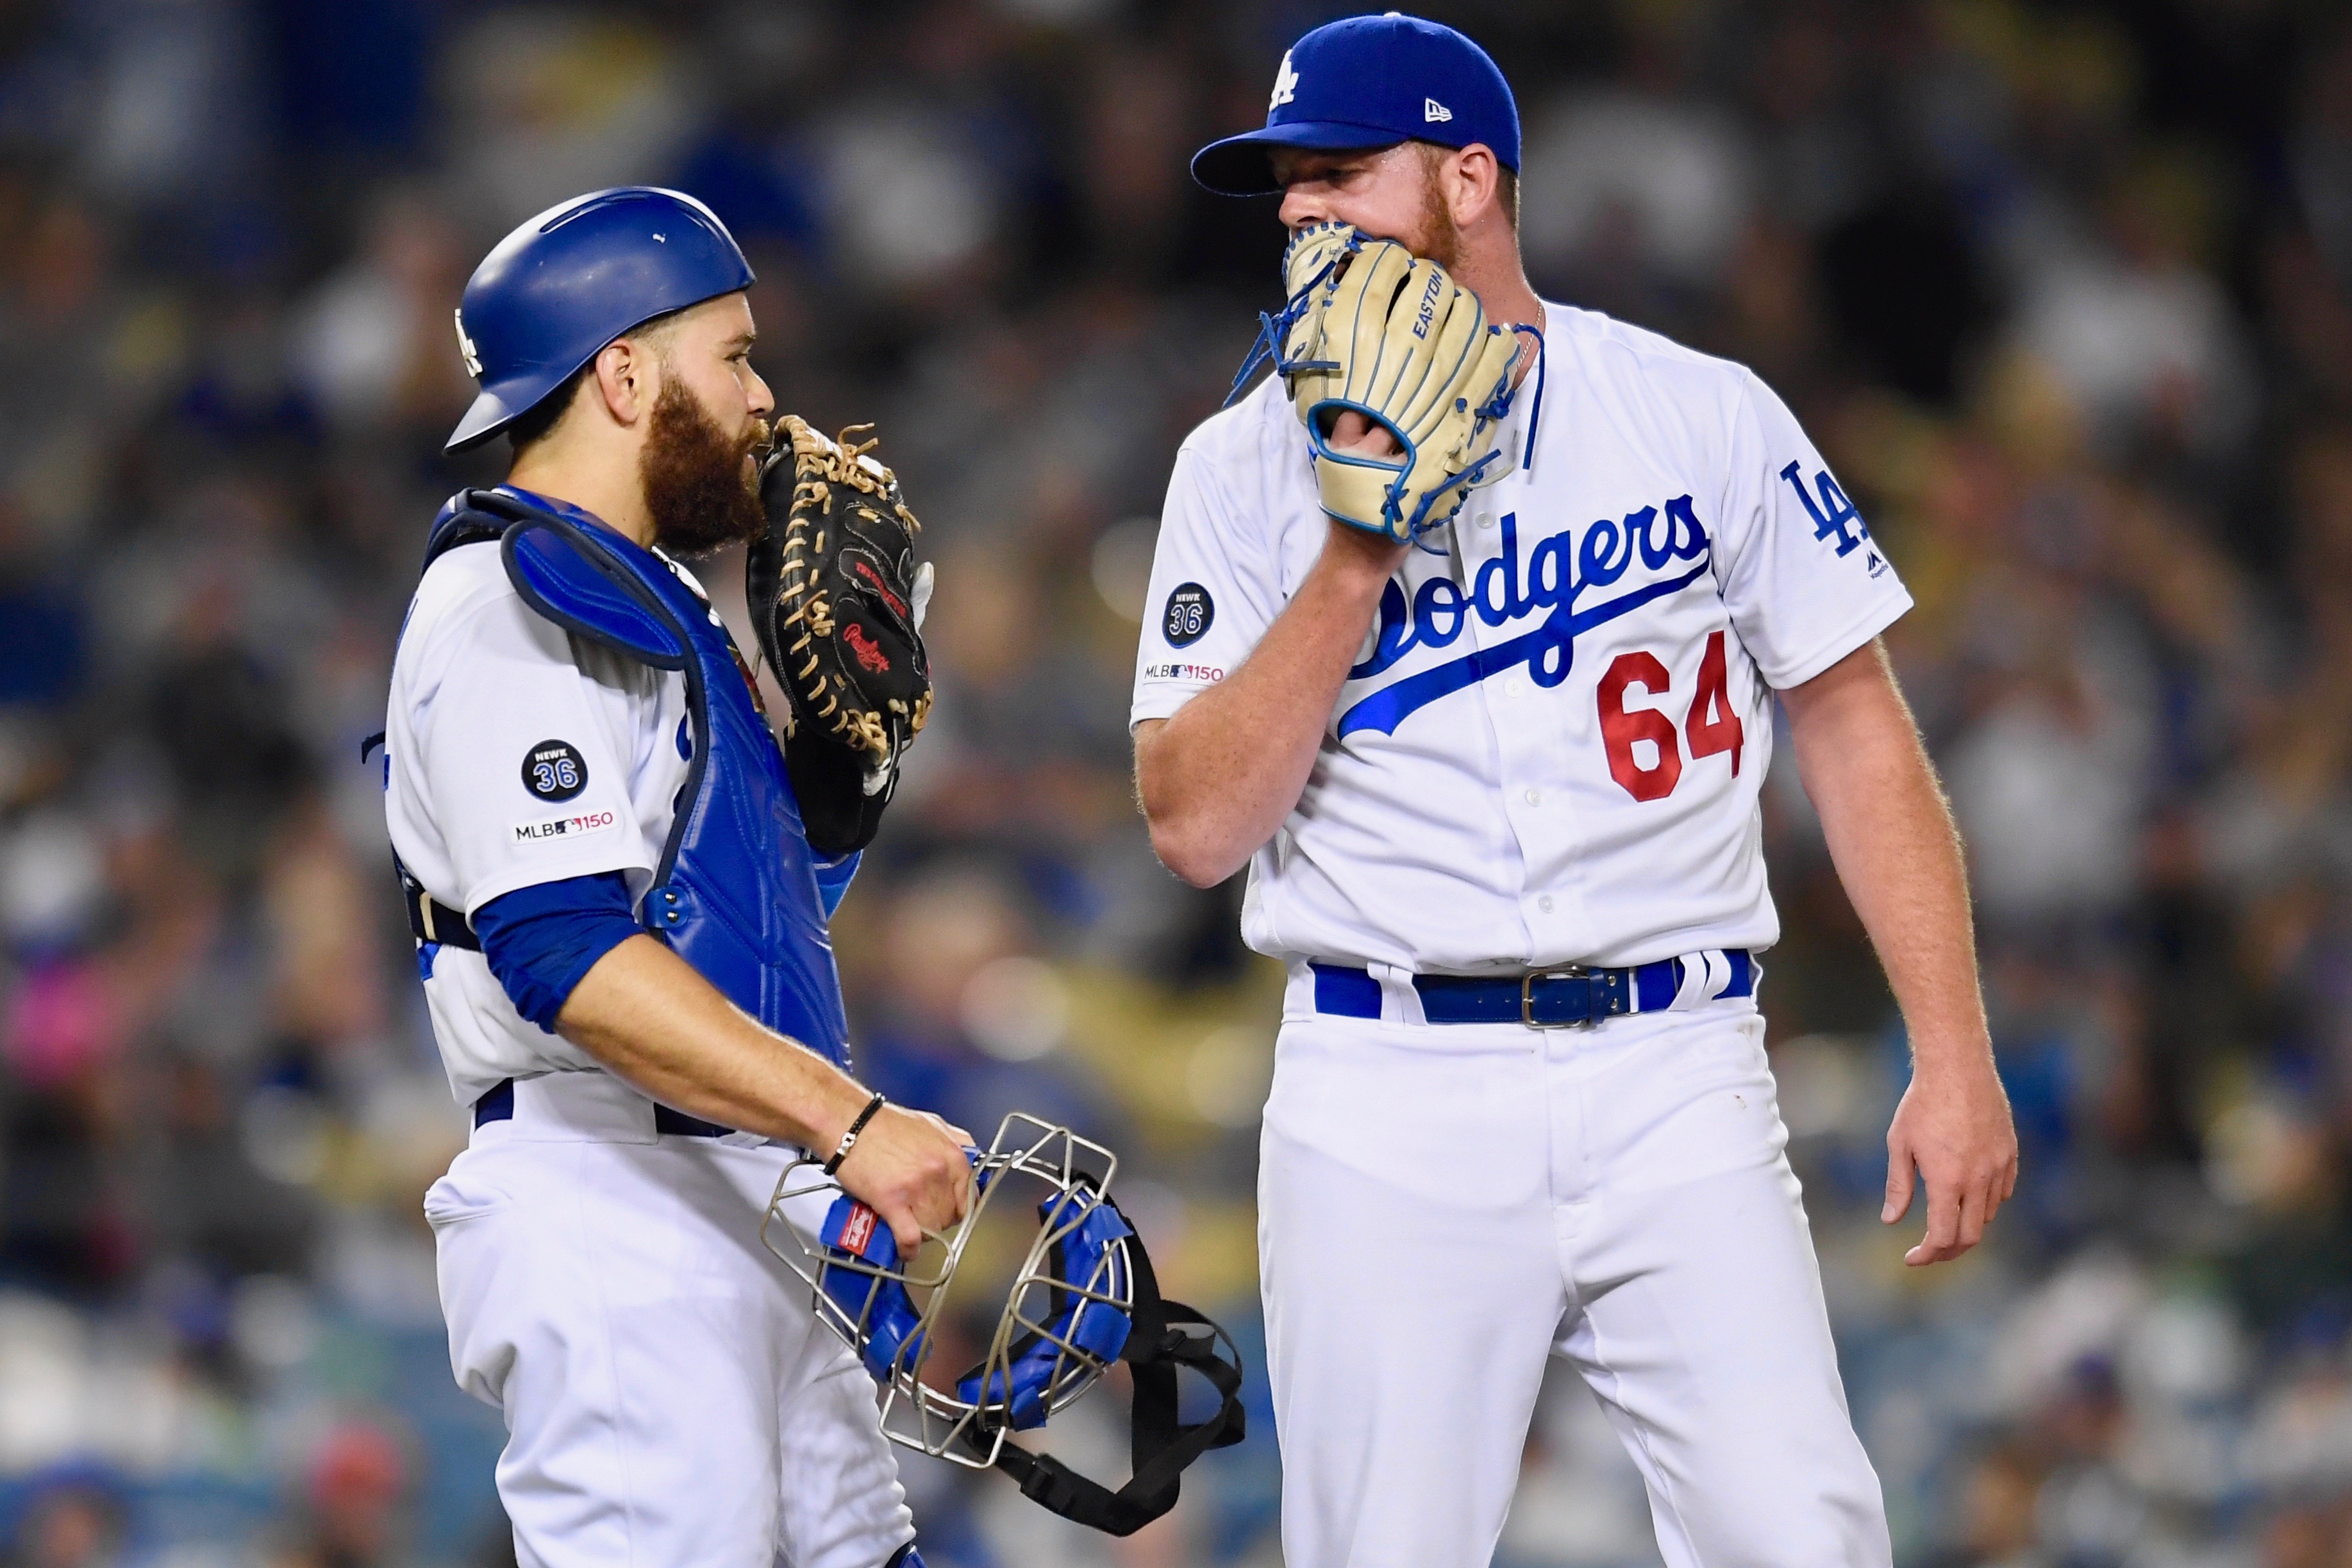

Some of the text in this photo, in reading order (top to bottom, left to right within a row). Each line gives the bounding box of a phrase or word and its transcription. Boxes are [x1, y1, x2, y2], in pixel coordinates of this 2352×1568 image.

[1412, 268, 1442, 340] EASTON
[1780, 459, 1869, 558] LA
[1176, 593, 1201, 603] NEWK
[1169, 603, 1203, 635] 36
[1144, 665, 1224, 681] MLB 150
[1597, 630, 1744, 803] 64
[535, 748, 567, 762] NEWK
[533, 758, 579, 792] 36
[515, 812, 613, 840] MLB 150
